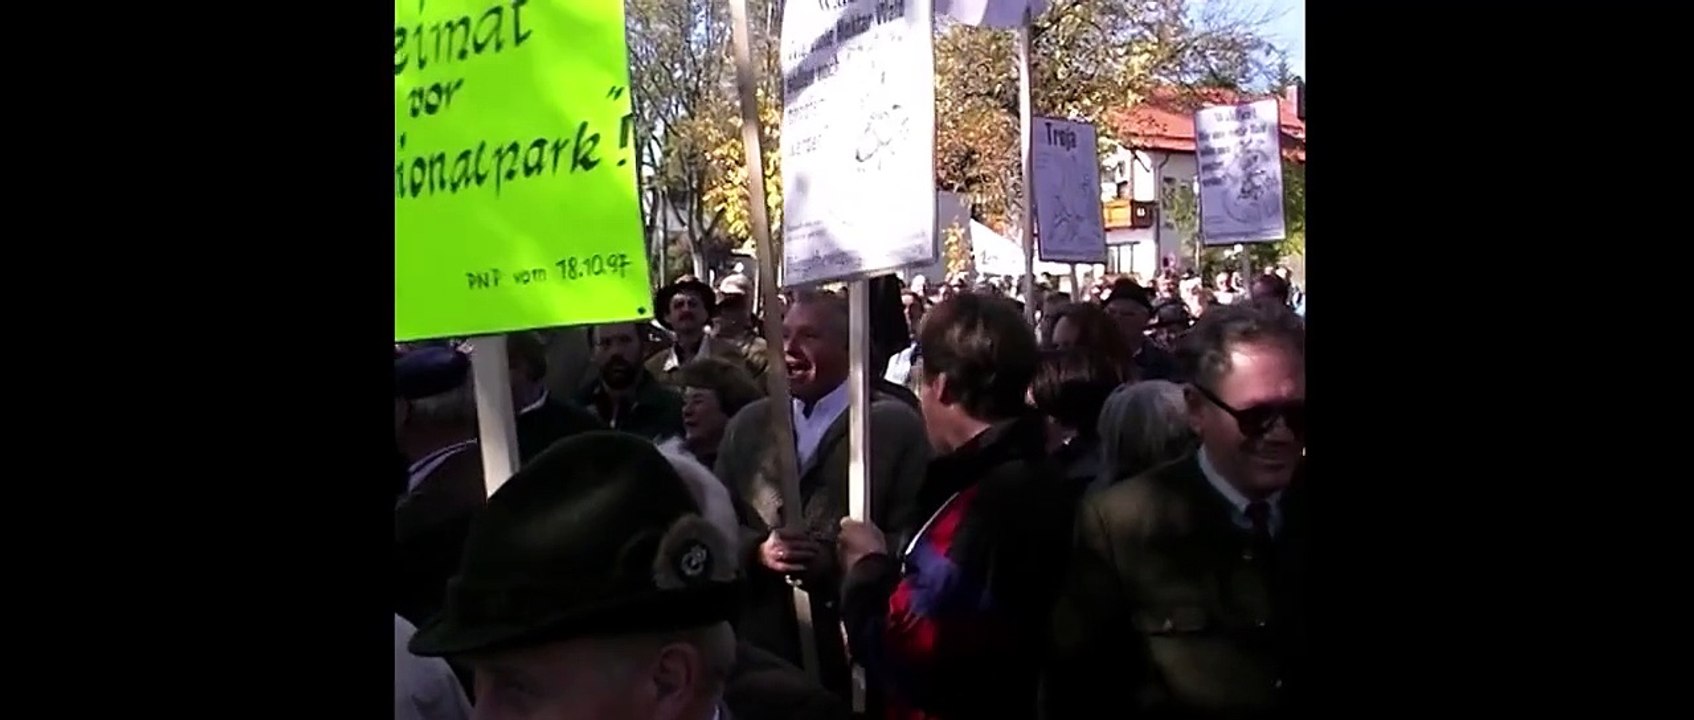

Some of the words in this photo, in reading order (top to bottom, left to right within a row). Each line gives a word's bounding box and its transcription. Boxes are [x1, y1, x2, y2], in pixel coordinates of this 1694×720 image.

[408, 78, 464, 118] vor
[1045, 122, 1077, 151] Troja
[513, 268, 547, 285] vom
